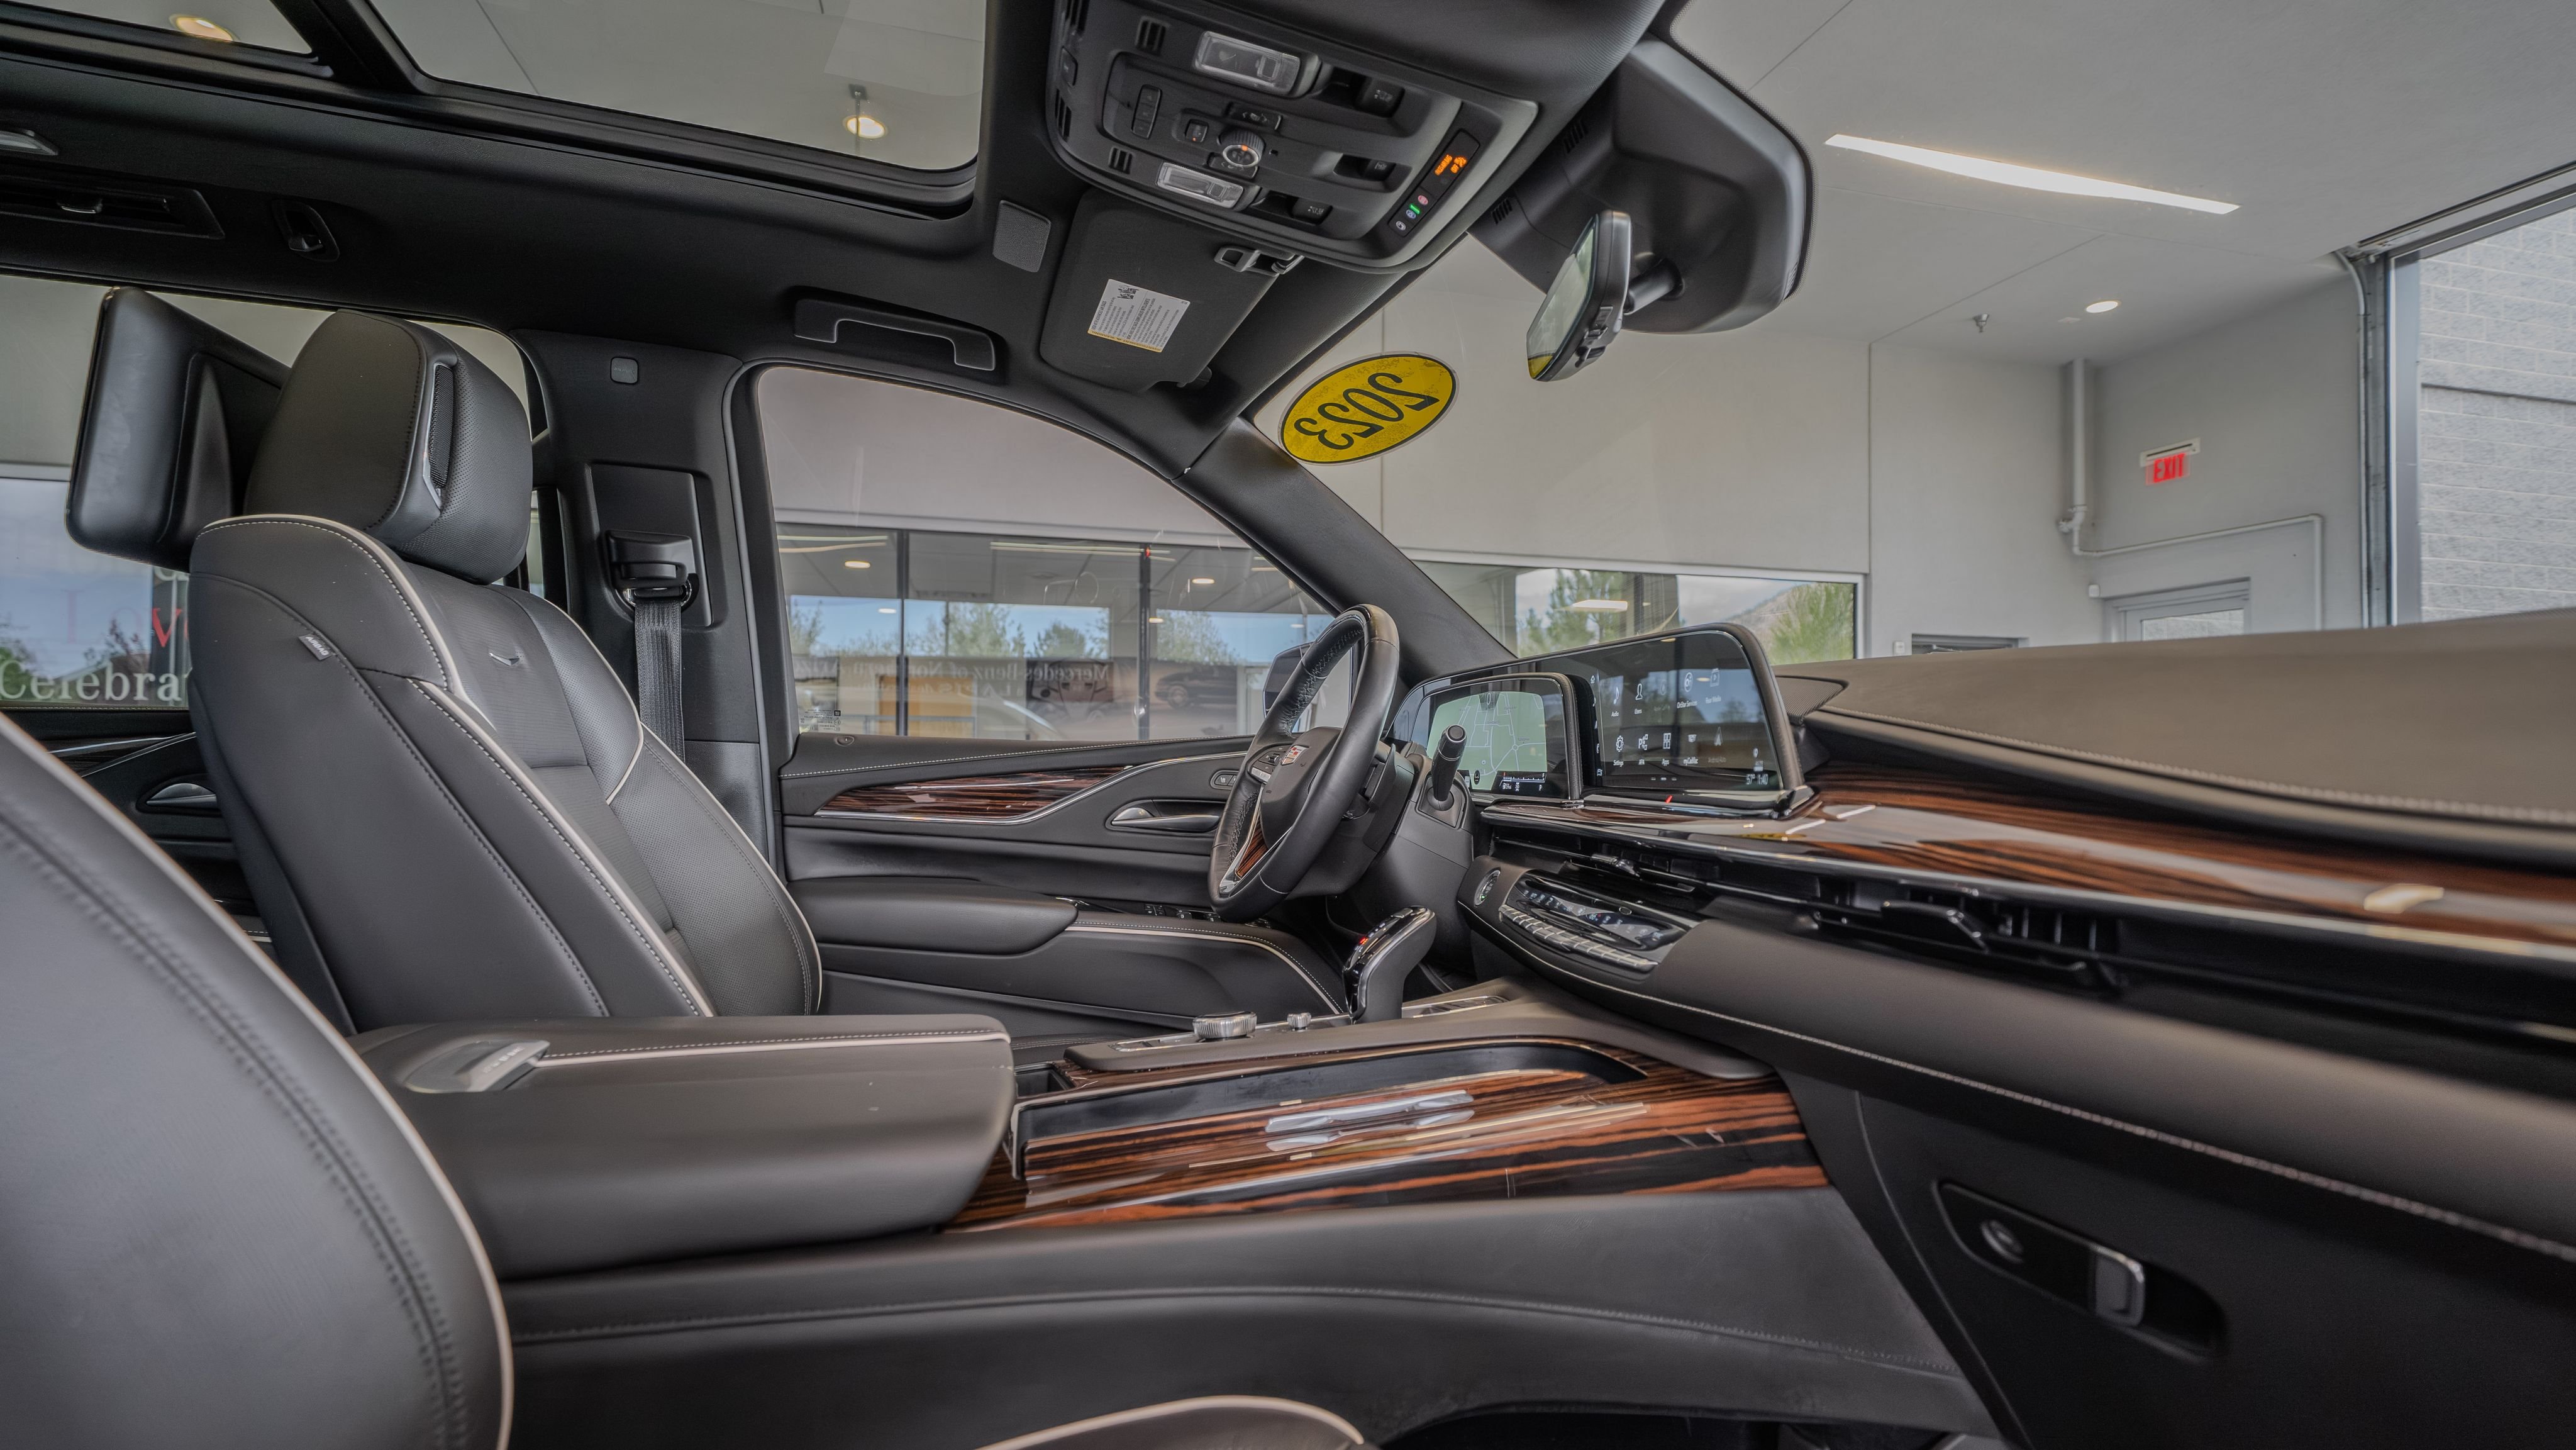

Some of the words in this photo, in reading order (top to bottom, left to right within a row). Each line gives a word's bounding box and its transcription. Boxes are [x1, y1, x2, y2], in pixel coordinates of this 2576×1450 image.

[2153, 452, 2187, 484] EXIT
[305, 637, 330, 656] AIRBAG
[0, 660, 189, 703] Celebra
